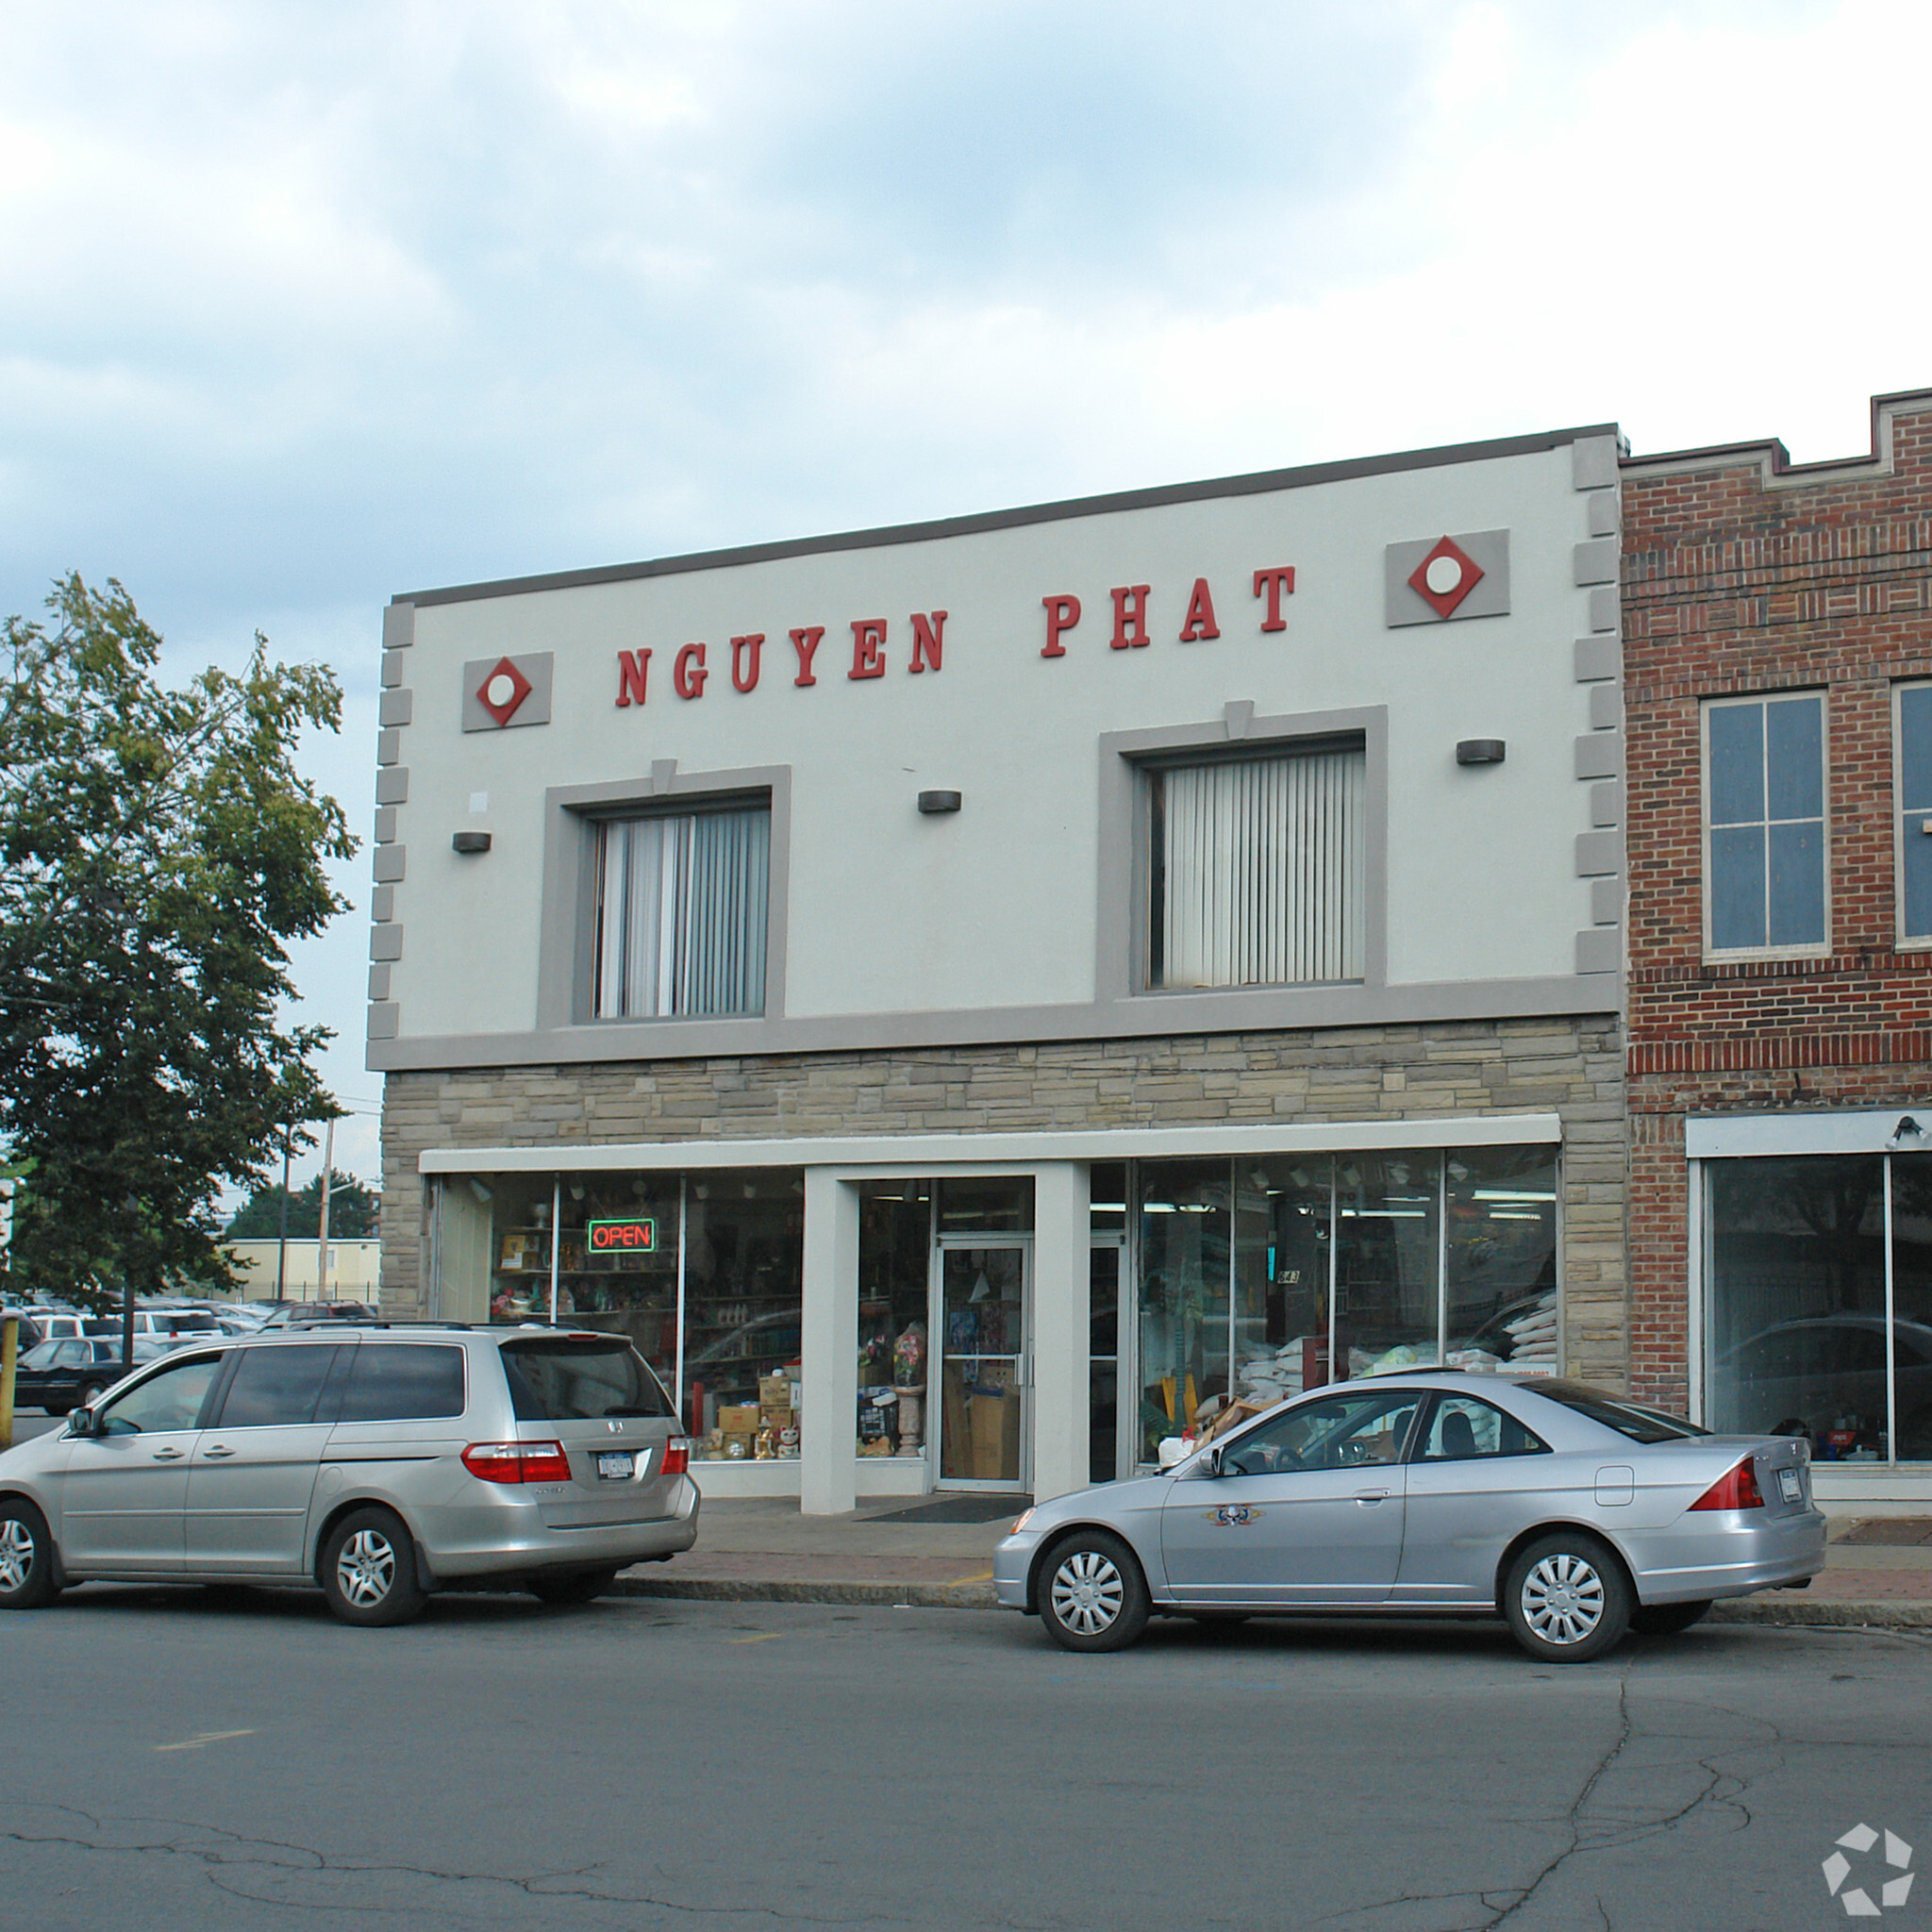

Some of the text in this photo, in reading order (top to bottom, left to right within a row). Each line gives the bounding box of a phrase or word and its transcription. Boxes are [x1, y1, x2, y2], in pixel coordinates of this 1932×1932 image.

[616, 566, 1295, 708] NGUYEN PHAT
[592, 1224, 651, 1248] OPEN
